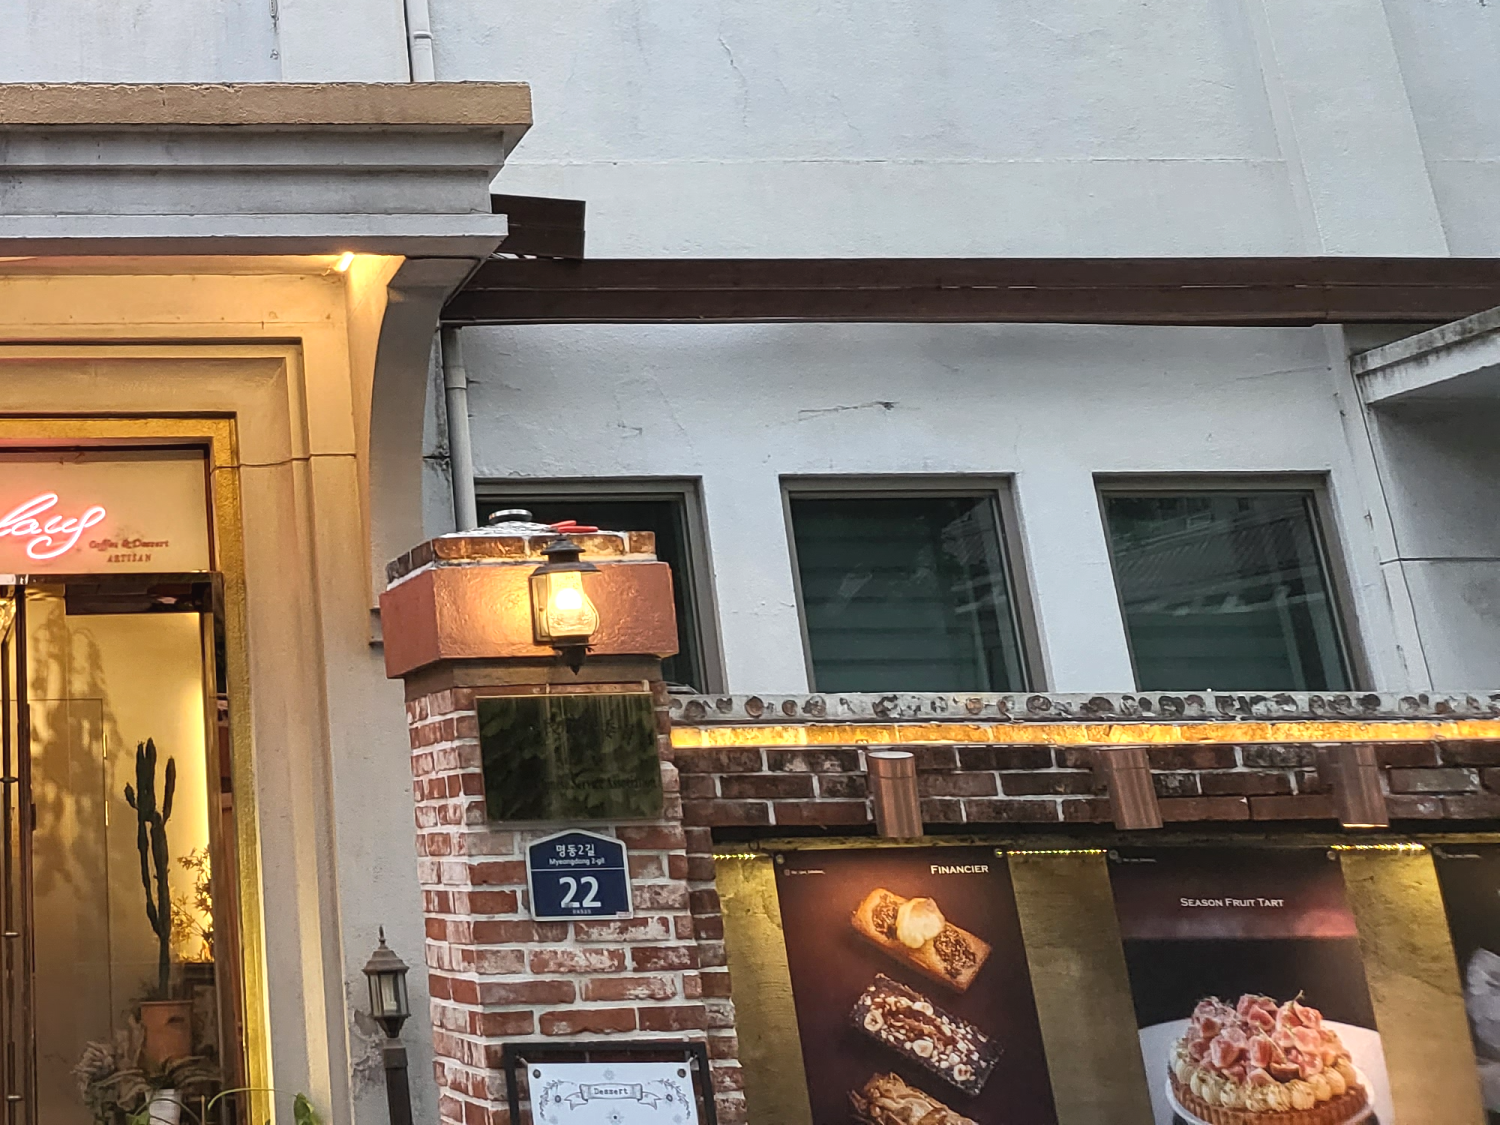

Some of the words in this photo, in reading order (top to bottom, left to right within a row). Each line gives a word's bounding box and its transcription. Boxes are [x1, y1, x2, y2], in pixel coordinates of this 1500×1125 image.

[107, 554, 151, 563] ARTISAN
[555, 844, 596, 857] 명동2길
[549, 858, 590, 867] Myeongdong
[591, 857, 605, 866] 2-gil
[930, 864, 989, 875] FINANCIER
[559, 876, 602, 908] 22
[1180, 898, 1223, 907] SEASON
[1225, 898, 1255, 907] FRUIT
[1257, 898, 1284, 907] TART
[593, 1087, 629, 1096] Dessert
